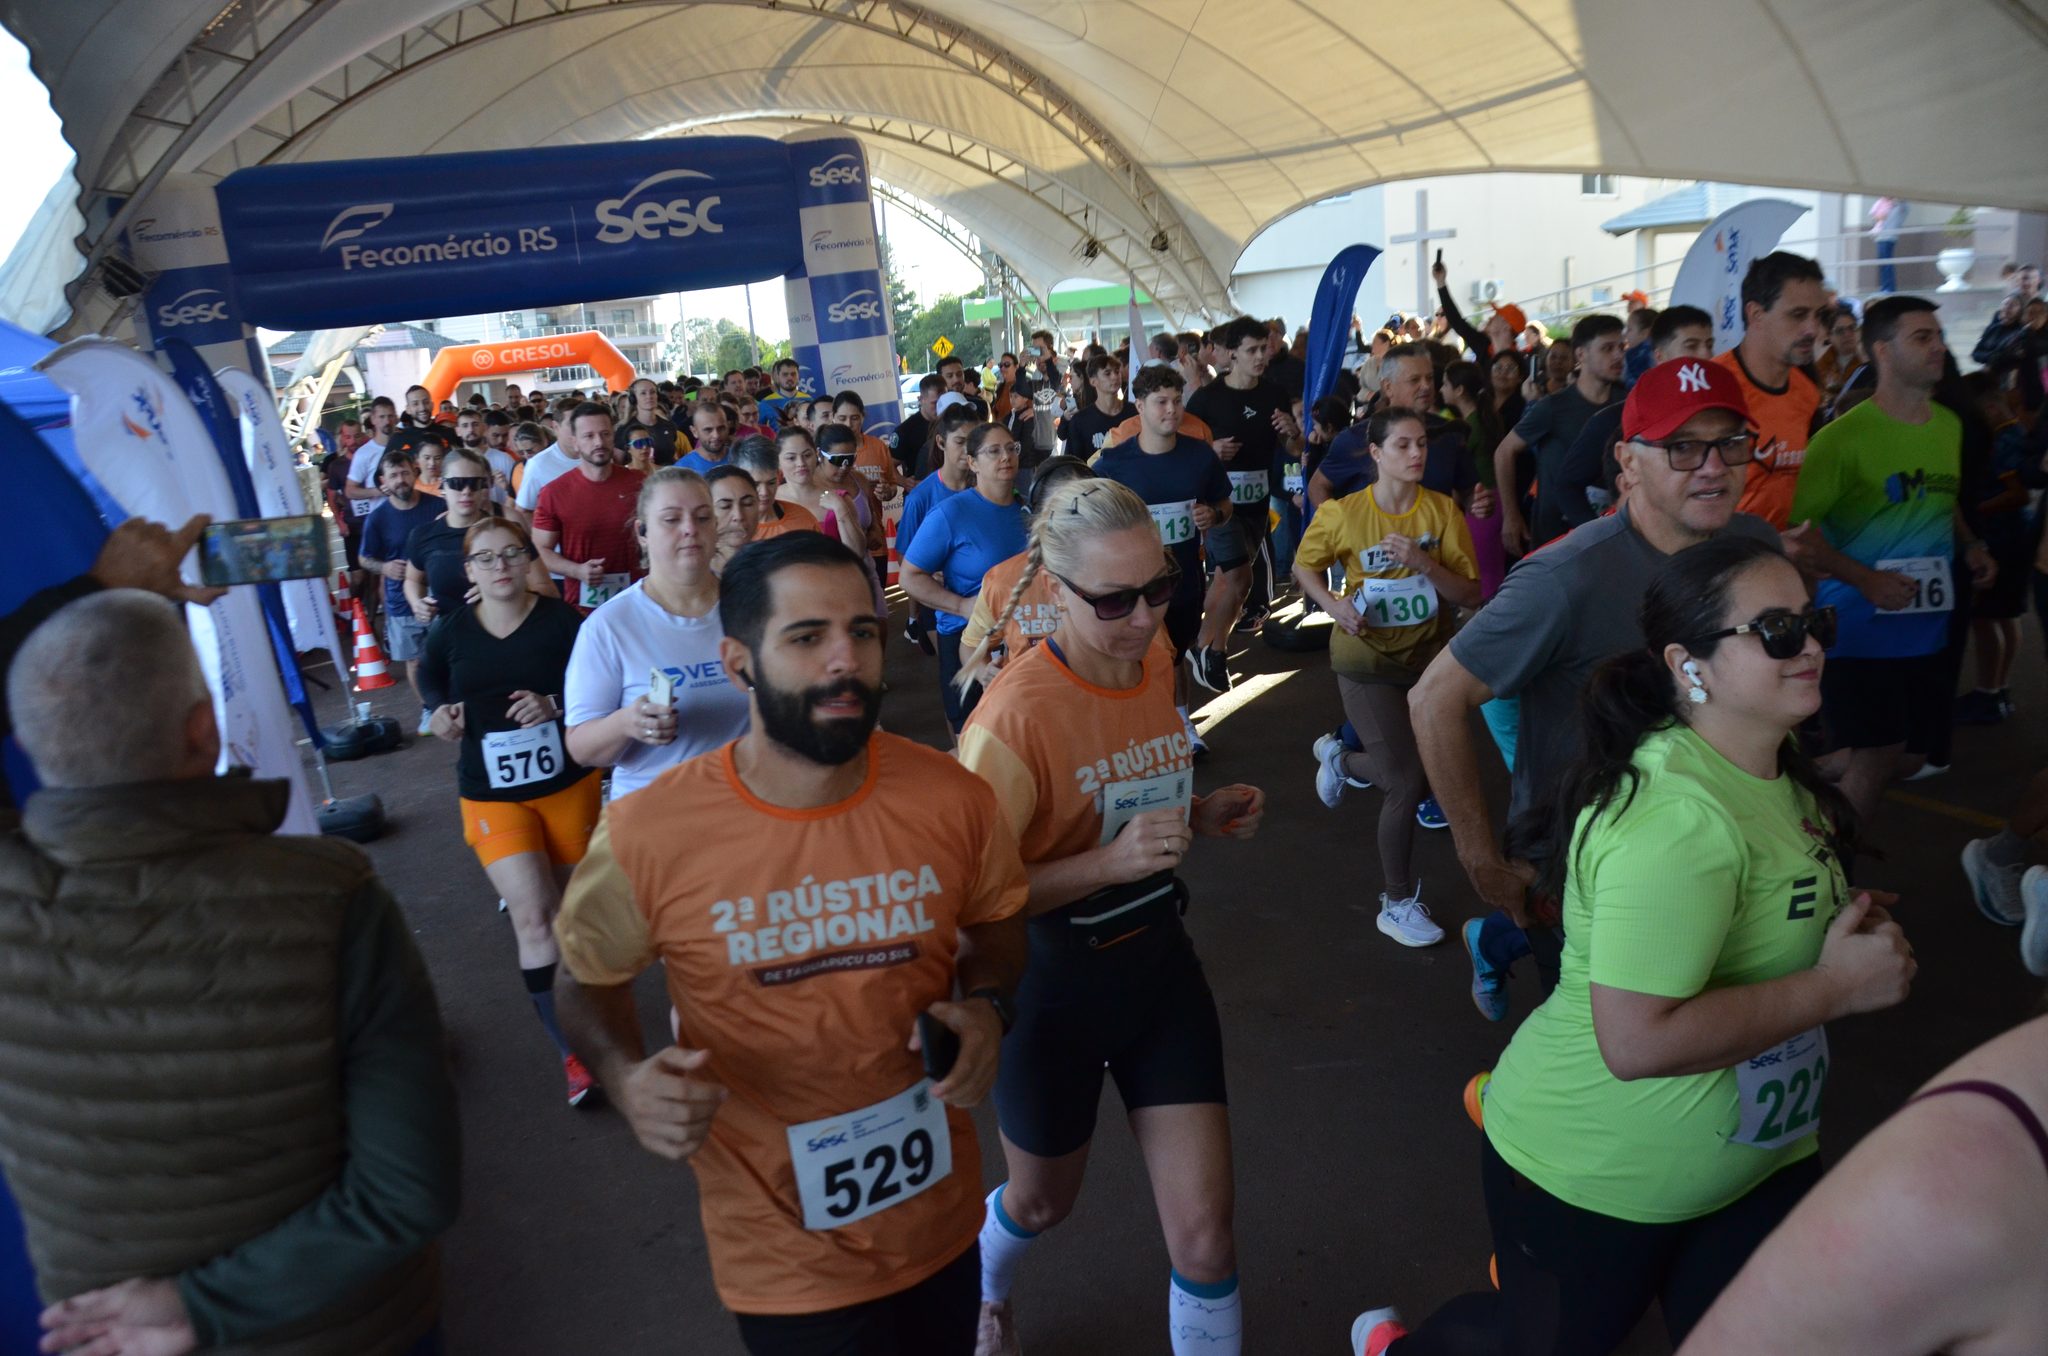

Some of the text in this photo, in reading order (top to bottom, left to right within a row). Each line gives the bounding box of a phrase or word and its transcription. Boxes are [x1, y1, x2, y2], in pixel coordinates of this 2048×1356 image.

[809, 165, 862, 187] Sesc
[595, 195, 723, 244] Sesc
[341, 226, 558, 271] Fecomércio RS
[158, 301, 229, 327] Sesc
[828, 301, 881, 322] Sesc
[500, 343, 576, 365] CRESOL
[800, 377, 816, 392] sc
[1234, 483, 1264, 501] 103
[586, 586, 624, 605] 21
[1914, 578, 1944, 608] 16
[1375, 594, 1430, 623] 130
[497, 745, 555, 783] 576
[1075, 758, 1112, 794] 2ª
[1112, 732, 1189, 778] RÚSTIC
[1114, 797, 1140, 810] Sesc
[710, 864, 943, 933] 2ª RÚSTICA
[727, 900, 936, 966] REGIONAL
[1750, 1051, 1783, 1070] Sesc
[807, 1132, 849, 1152] Sesc
[825, 1128, 934, 1218] 529
